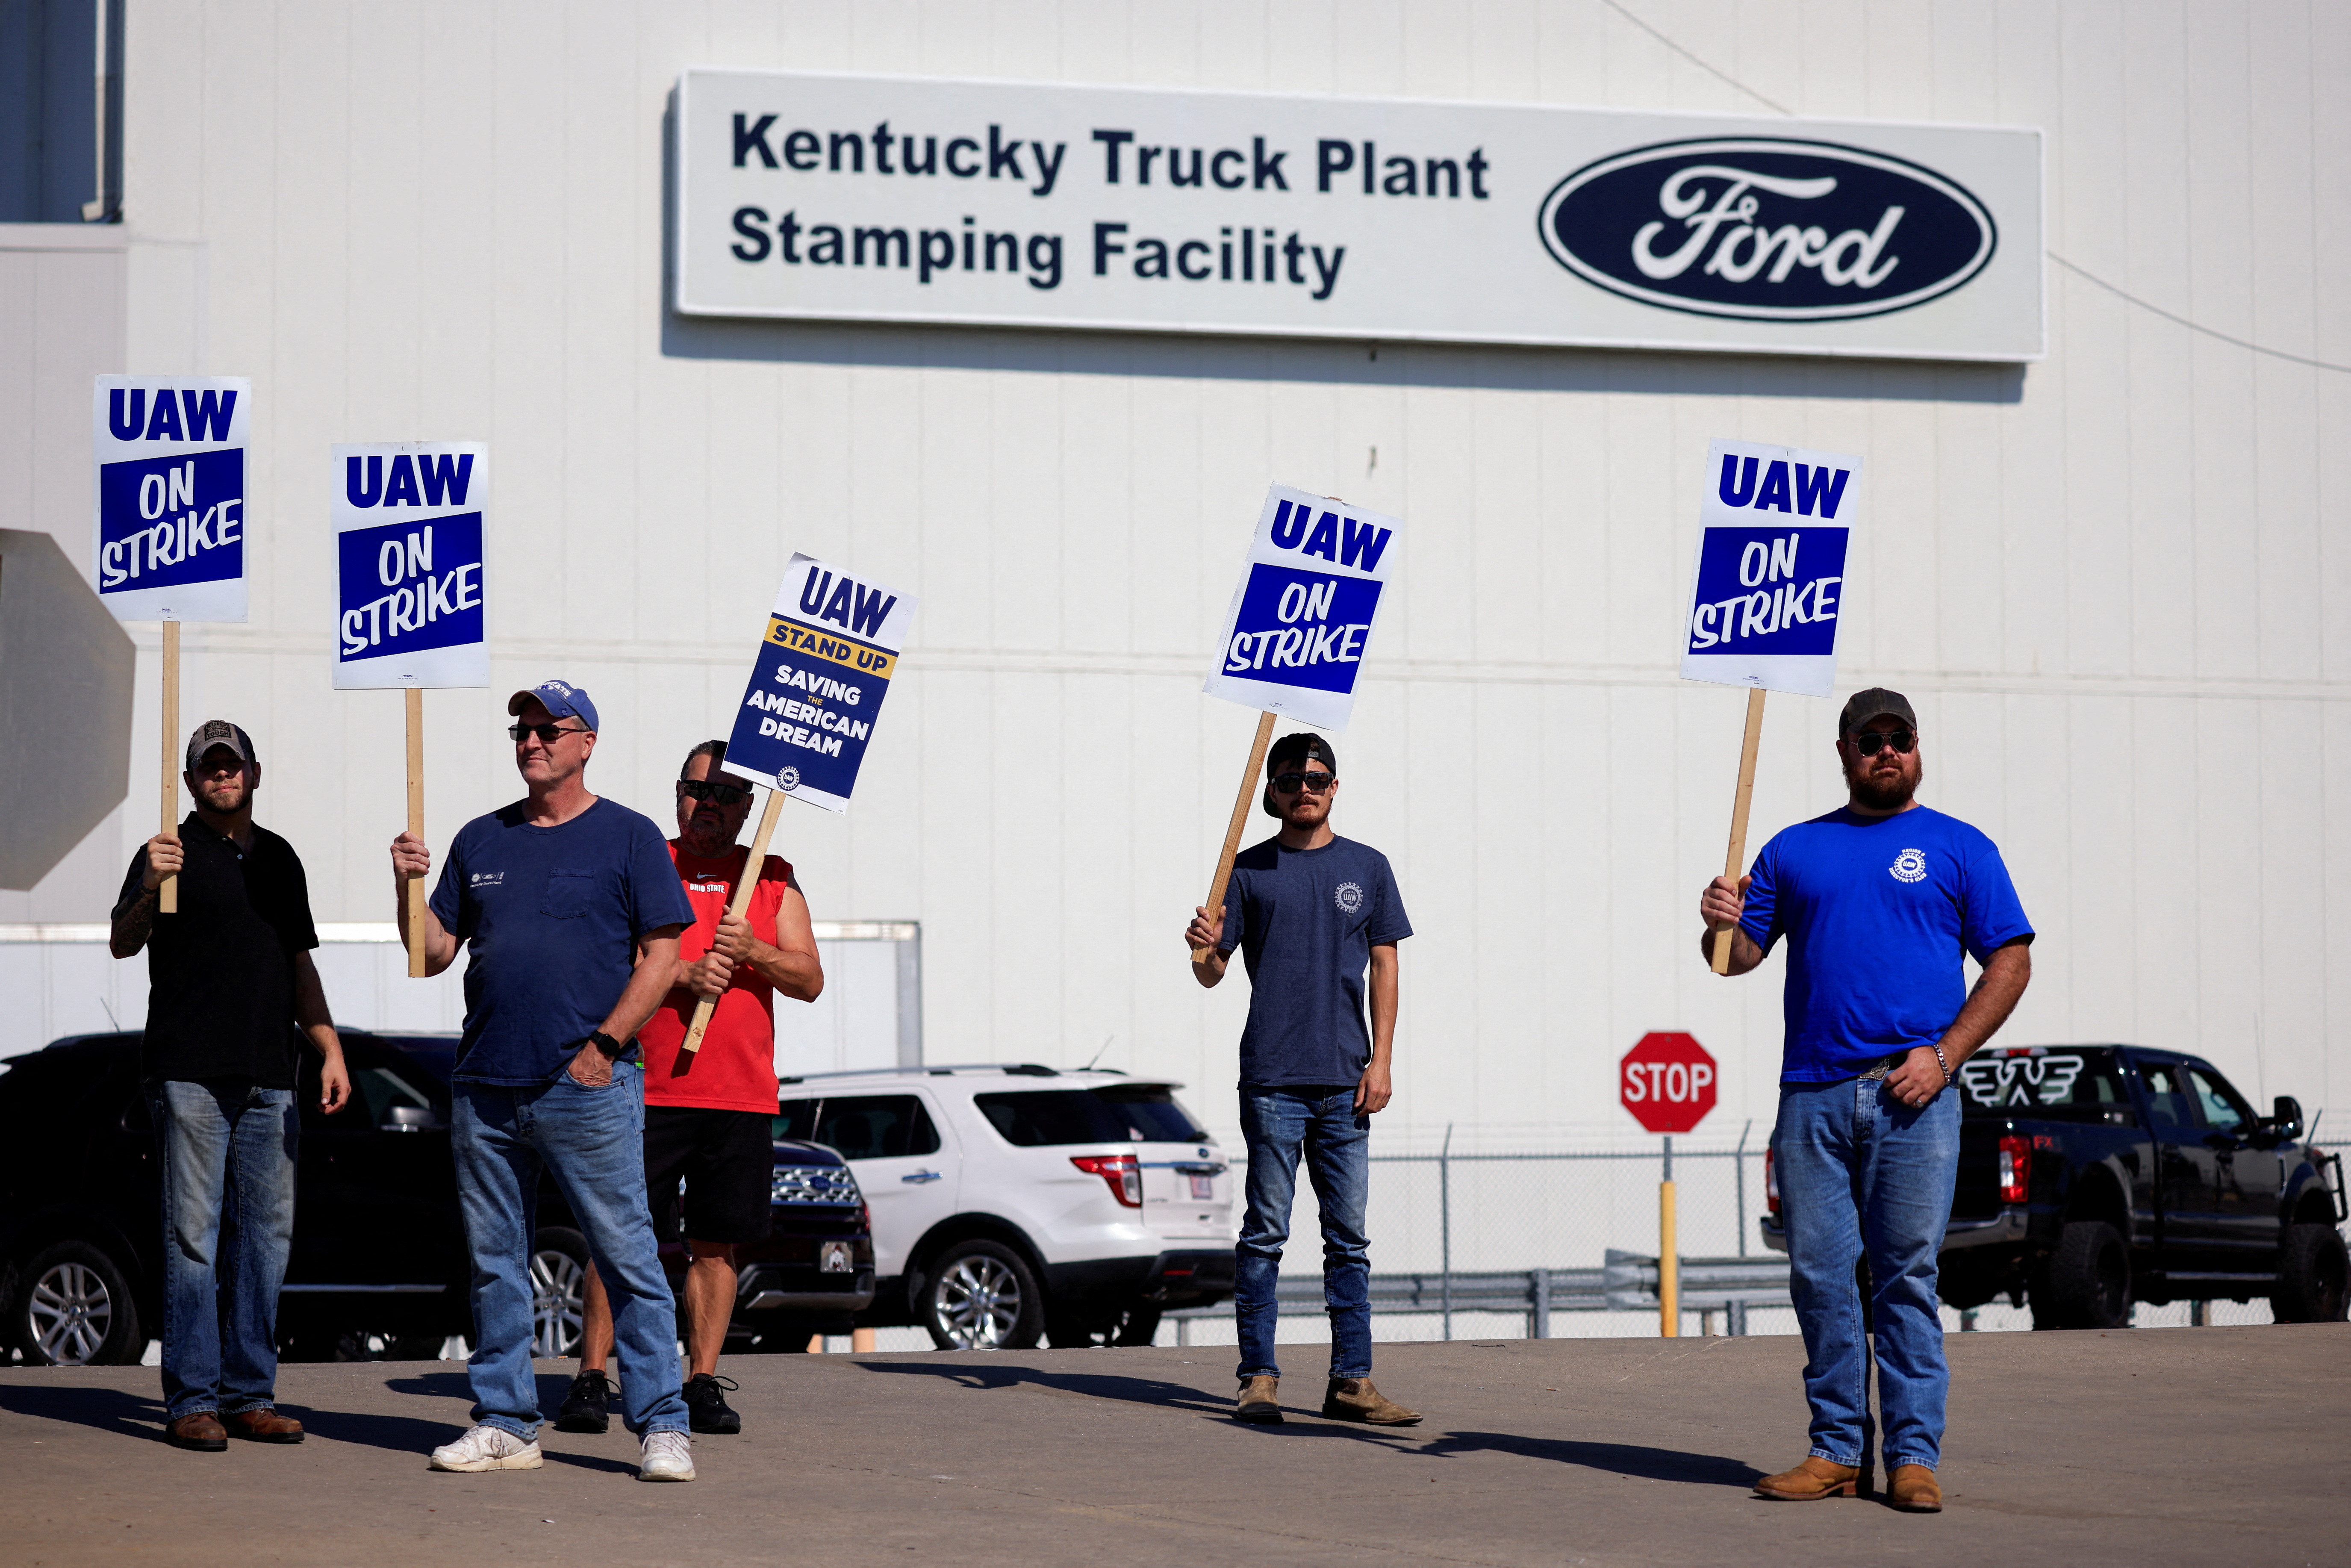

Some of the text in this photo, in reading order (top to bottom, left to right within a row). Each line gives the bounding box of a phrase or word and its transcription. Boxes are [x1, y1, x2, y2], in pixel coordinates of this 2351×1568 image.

[731, 111, 1490, 200] Kentucky Truck Plant
[730, 205, 1346, 302] Stamping Facility
[1631, 165, 1905, 289] Ford
[109, 388, 238, 442] UAW
[139, 460, 194, 519] ON
[347, 454, 474, 509] UAW
[1718, 453, 1851, 519] UAW
[101, 498, 242, 588] STRIKE
[379, 525, 433, 587] ON
[1270, 498, 1393, 573] UAW
[1739, 532, 1800, 587] ON
[341, 562, 482, 656] STRIKE
[799, 565, 898, 639] UAW
[1277, 580, 1338, 624] ON
[1691, 576, 1842, 649] STRIKE
[772, 624, 888, 672] STAND UP
[1226, 623, 1370, 672] STRIKE
[774, 664, 862, 706] SAVING
[807, 695, 823, 706] THE
[746, 686, 870, 741] AMERICAN
[758, 716, 843, 758] DREAM
[689, 883, 705, 893] OHIO
[1343, 893, 1357, 902] UAW
[1888, 867, 1927, 883] DIRECTOR'S CLUB
[1624, 1061, 1714, 1103] STOP
